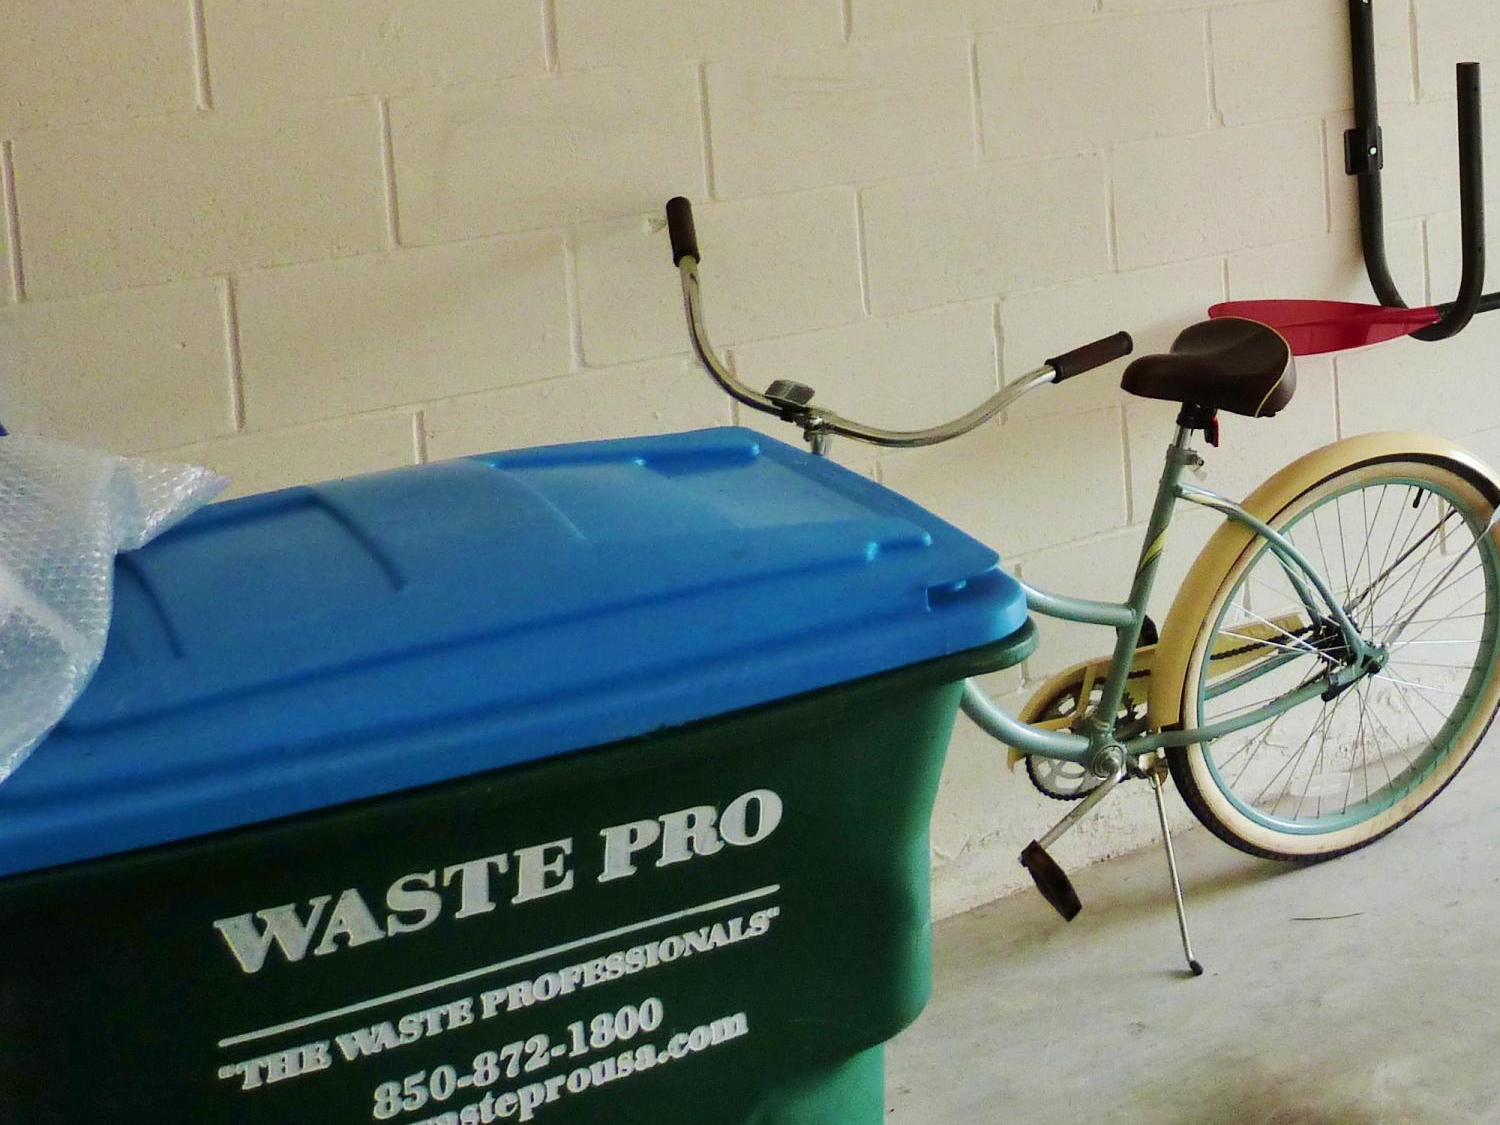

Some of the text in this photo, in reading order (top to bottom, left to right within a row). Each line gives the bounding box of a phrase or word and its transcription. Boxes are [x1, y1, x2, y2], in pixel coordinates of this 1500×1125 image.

[213, 788, 784, 974] WASTE PRO
[335, 997, 474, 1062] WASTE
[372, 997, 665, 1121] 850-872-1800
